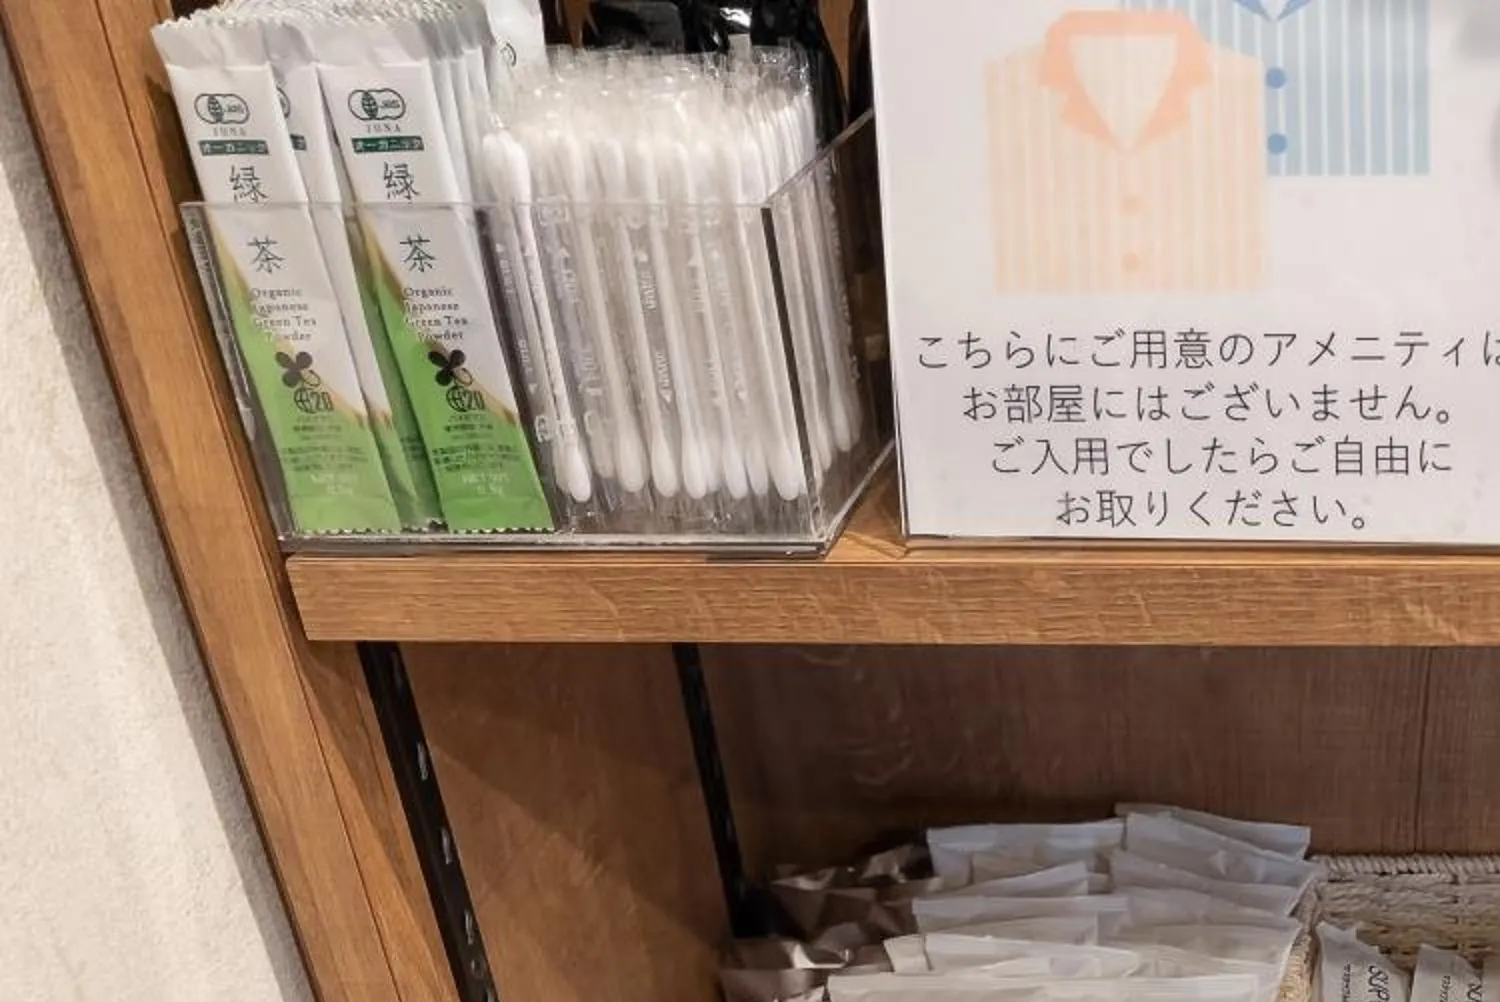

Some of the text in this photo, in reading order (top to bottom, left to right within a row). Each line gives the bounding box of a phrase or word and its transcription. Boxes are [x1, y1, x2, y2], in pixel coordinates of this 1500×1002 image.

[404, 286, 453, 298] Organic
[962, 383, 1453, 424] お部屋にはございません。
[991, 436, 1453, 476] ご入用でしたらご自由に
[1056, 489, 1369, 529] お取りください。
